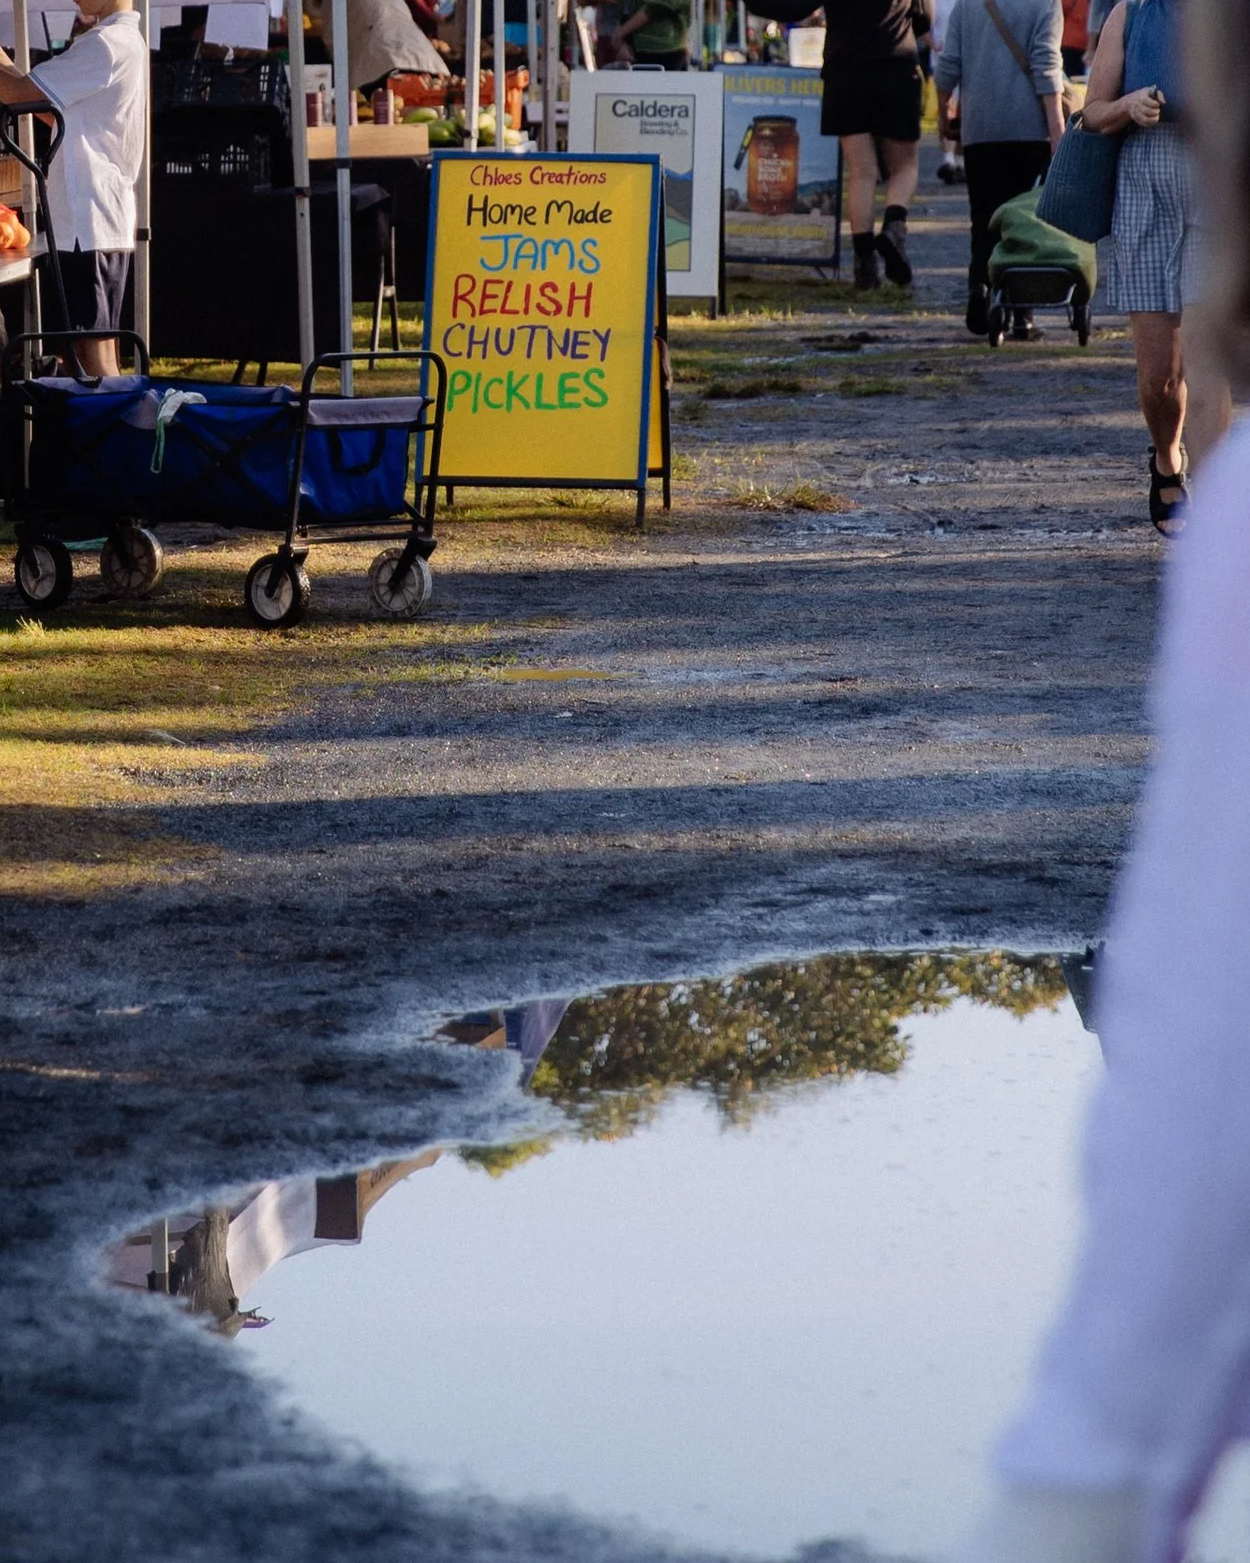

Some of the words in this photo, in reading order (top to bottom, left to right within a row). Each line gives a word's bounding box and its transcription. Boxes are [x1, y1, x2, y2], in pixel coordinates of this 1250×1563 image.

[612, 99, 689, 118] Caldera
[470, 165, 523, 186] Chloes
[530, 164, 608, 185] Creations
[467, 194, 537, 227] Home
[545, 200, 613, 226] Made
[479, 234, 601, 274] JAMS
[452, 273, 594, 318] RELISH
[442, 323, 612, 362] CHUTNEY
[446, 368, 609, 414] PICKLES
